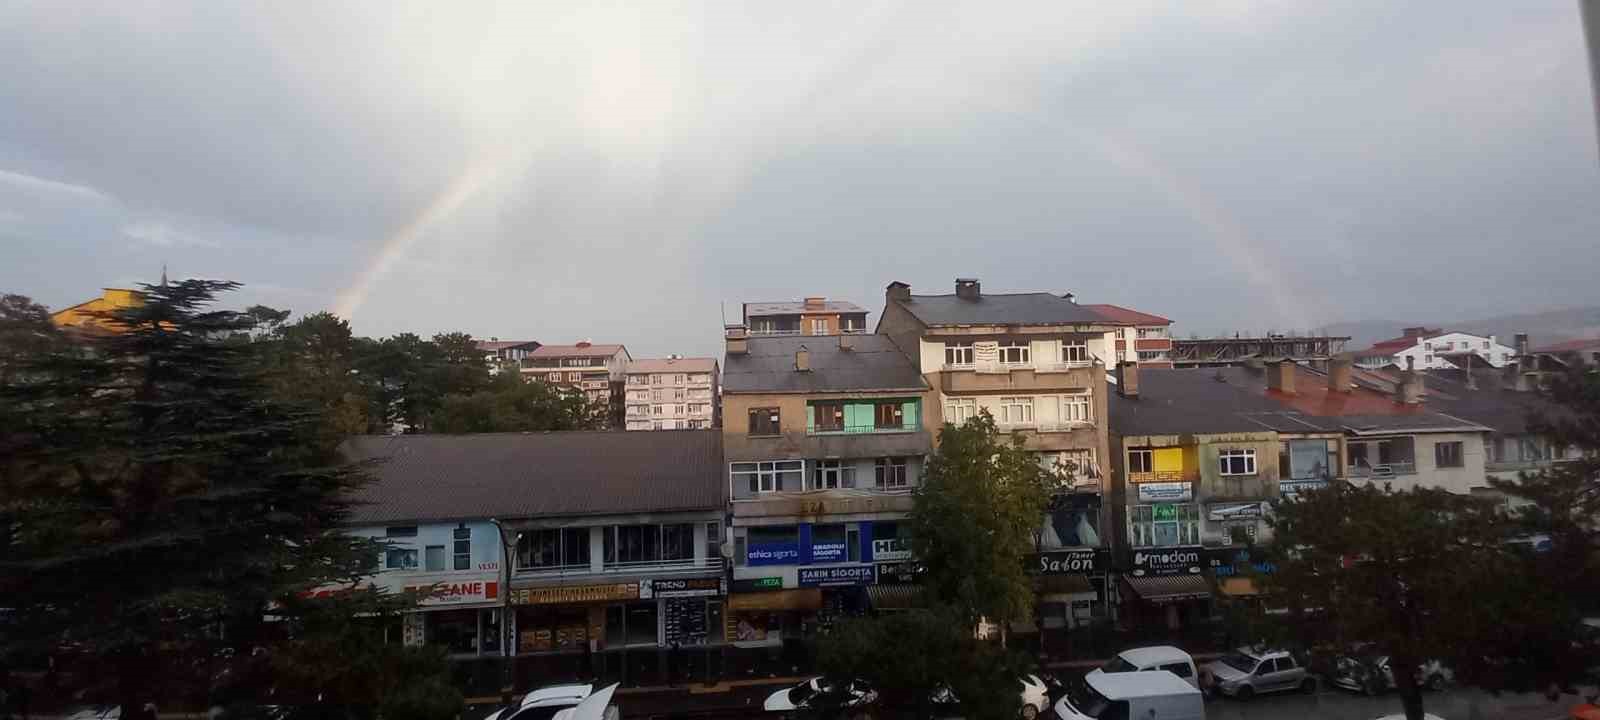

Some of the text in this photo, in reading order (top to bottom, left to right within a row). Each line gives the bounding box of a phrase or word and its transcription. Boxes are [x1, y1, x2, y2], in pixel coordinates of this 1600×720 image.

[749, 550, 798, 560] ethica sigorta
[1041, 552, 1093, 572] Salon
[655, 581, 686, 589] TREND
